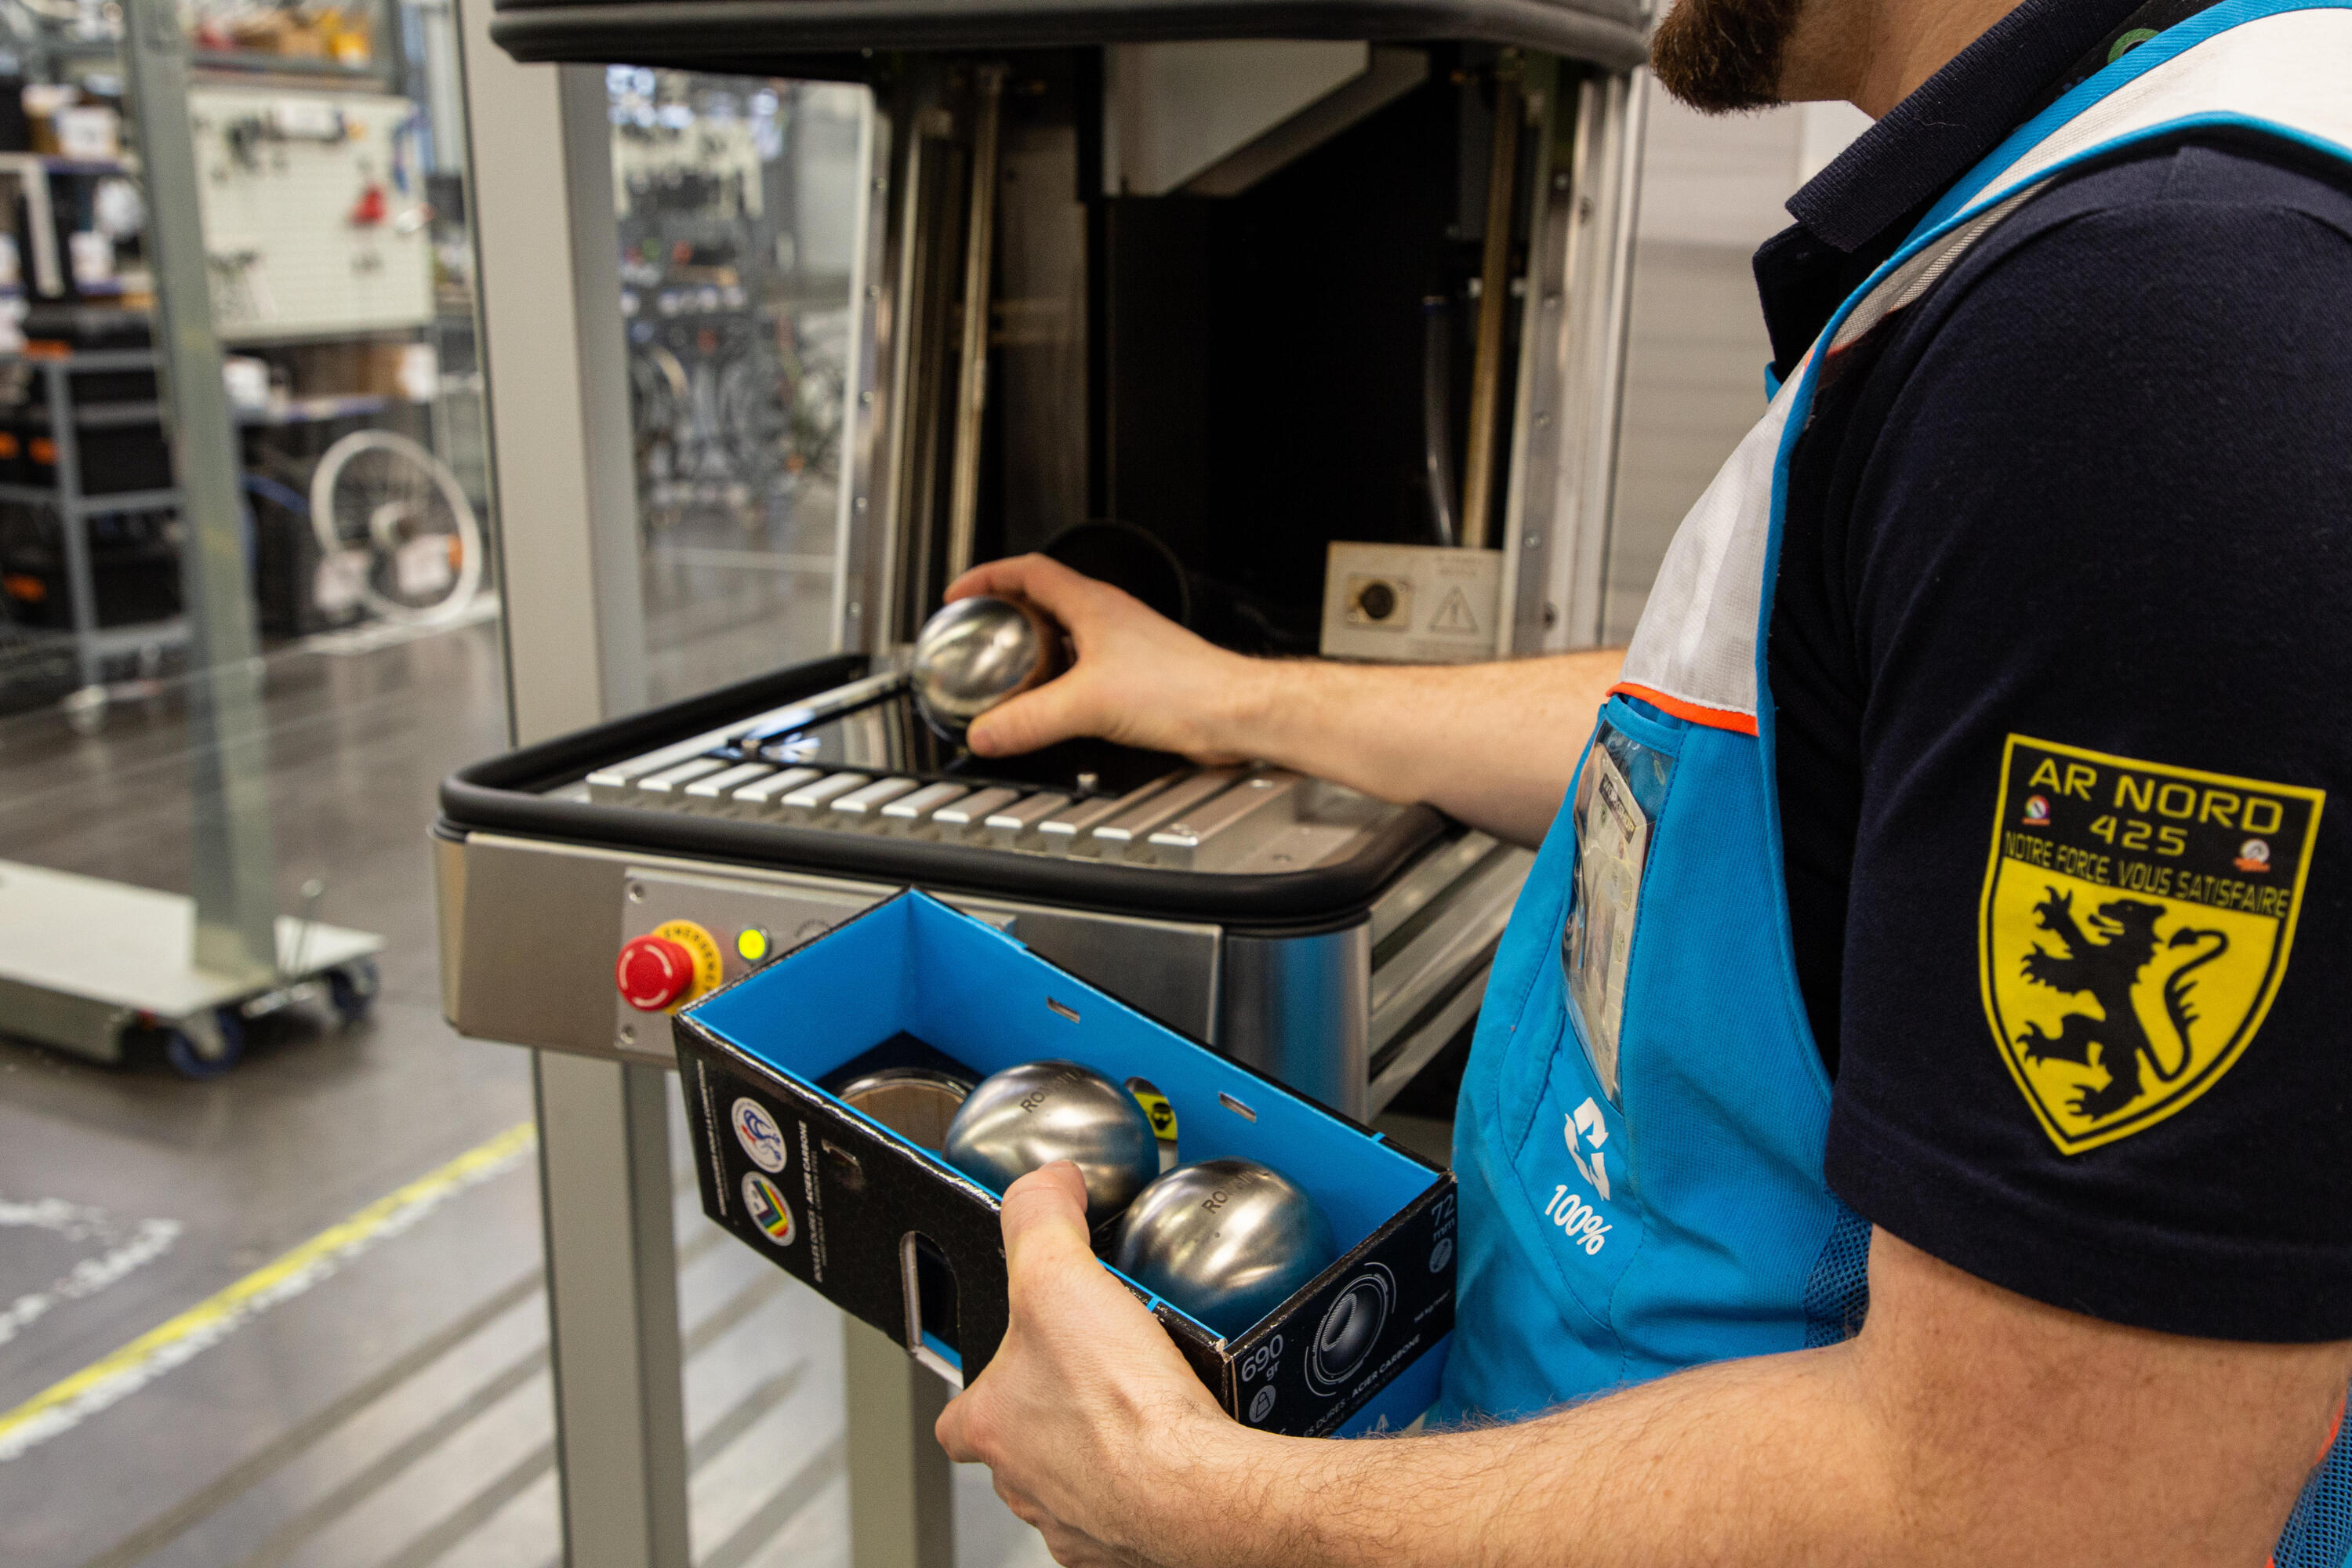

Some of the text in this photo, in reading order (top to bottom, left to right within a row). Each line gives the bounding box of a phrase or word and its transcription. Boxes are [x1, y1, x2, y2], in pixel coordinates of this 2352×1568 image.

[2028, 757, 2284, 835] AR NORD
[2089, 815, 2189, 857] 425
[2004, 830, 2054, 866] NOTRE
[2118, 860, 2173, 895] VOUS
[2176, 871, 2291, 918] SATISFAIRE
[798, 1120, 811, 1171] CARBONE
[1431, 1193, 1454, 1226] 72
[1432, 1218, 1455, 1242] mm
[1544, 1184, 1612, 1255] 100%
[1242, 1334, 1283, 1382] 690
[1266, 1362, 1279, 1382] gr
[1352, 1373, 1379, 1398] ACIER
[1379, 1334, 1421, 1374] CARBONE
